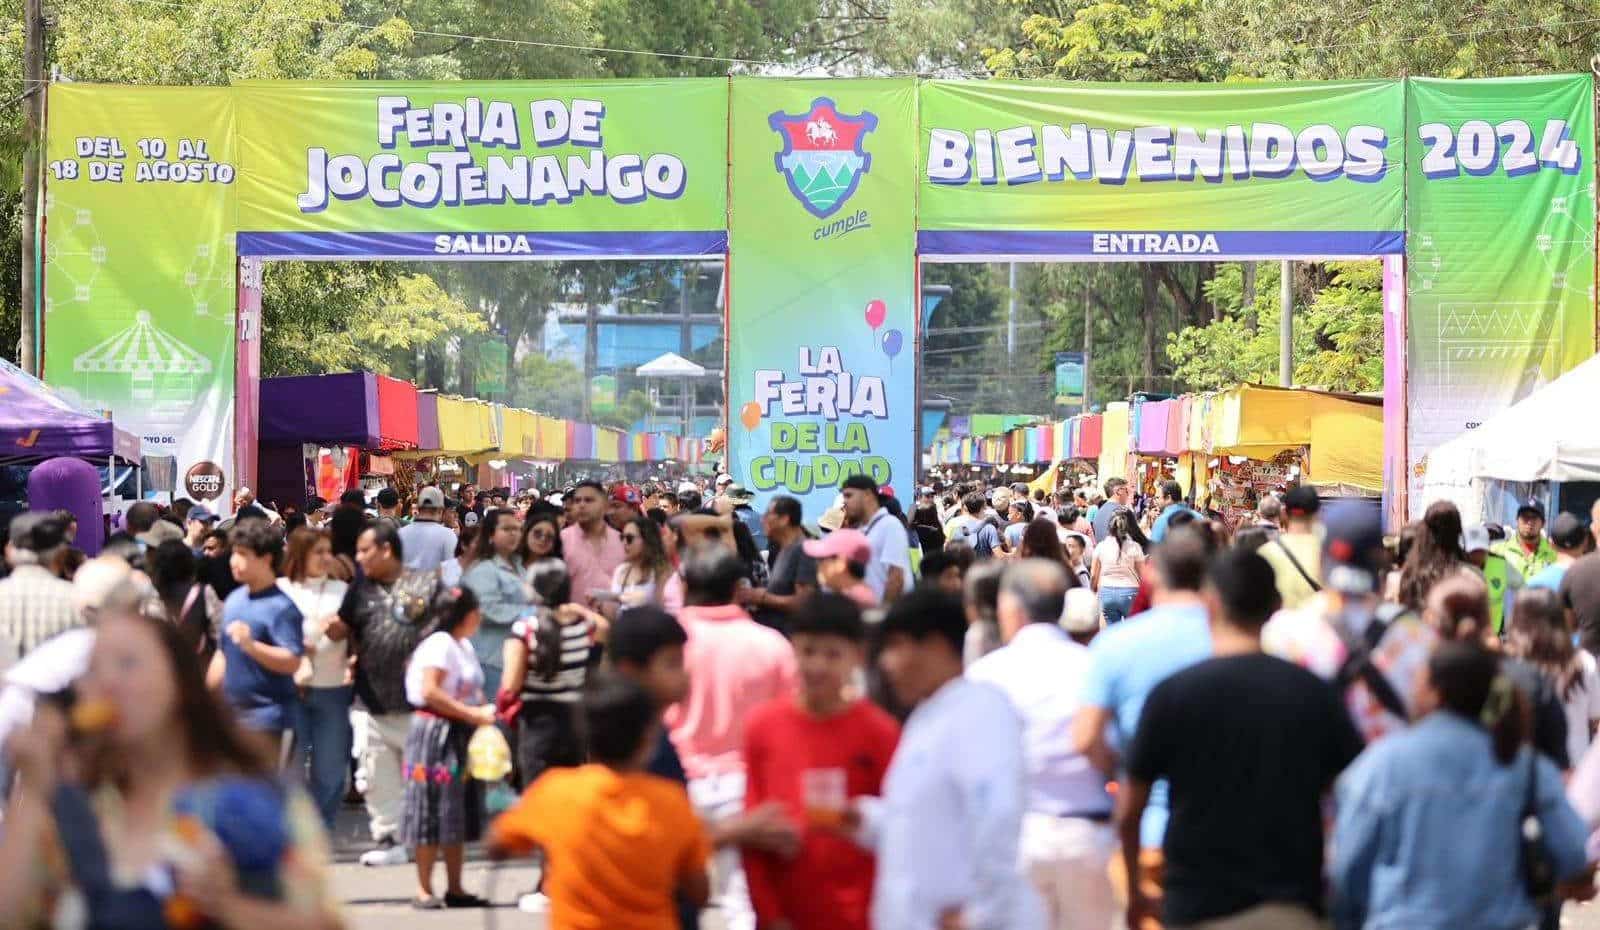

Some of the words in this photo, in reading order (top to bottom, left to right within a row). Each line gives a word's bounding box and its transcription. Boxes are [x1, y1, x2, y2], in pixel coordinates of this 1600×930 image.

[377, 96, 520, 150] FERIA
[530, 99, 605, 148] DE
[75, 137, 126, 158] DEL
[137, 138, 167, 158] 10
[177, 139, 209, 160] AL
[926, 121, 1388, 185] BIENVENIDOS
[1418, 119, 1582, 180] 2024
[51, 160, 79, 179] 18
[88, 161, 124, 182] DE
[135, 161, 236, 183] AGOSTO
[297, 147, 687, 212] JOCOTENANGO
[814, 209, 868, 240] cumple
[434, 234, 532, 254] SALIDA
[1092, 233, 1220, 254] ENTRADA
[799, 346, 842, 376] LA
[754, 369, 889, 421] FERIA
[771, 422, 820, 453] DE
[825, 422, 871, 453] LA
[192, 482, 219, 492] GOLD
[751, 455, 891, 494] CIUDAD
